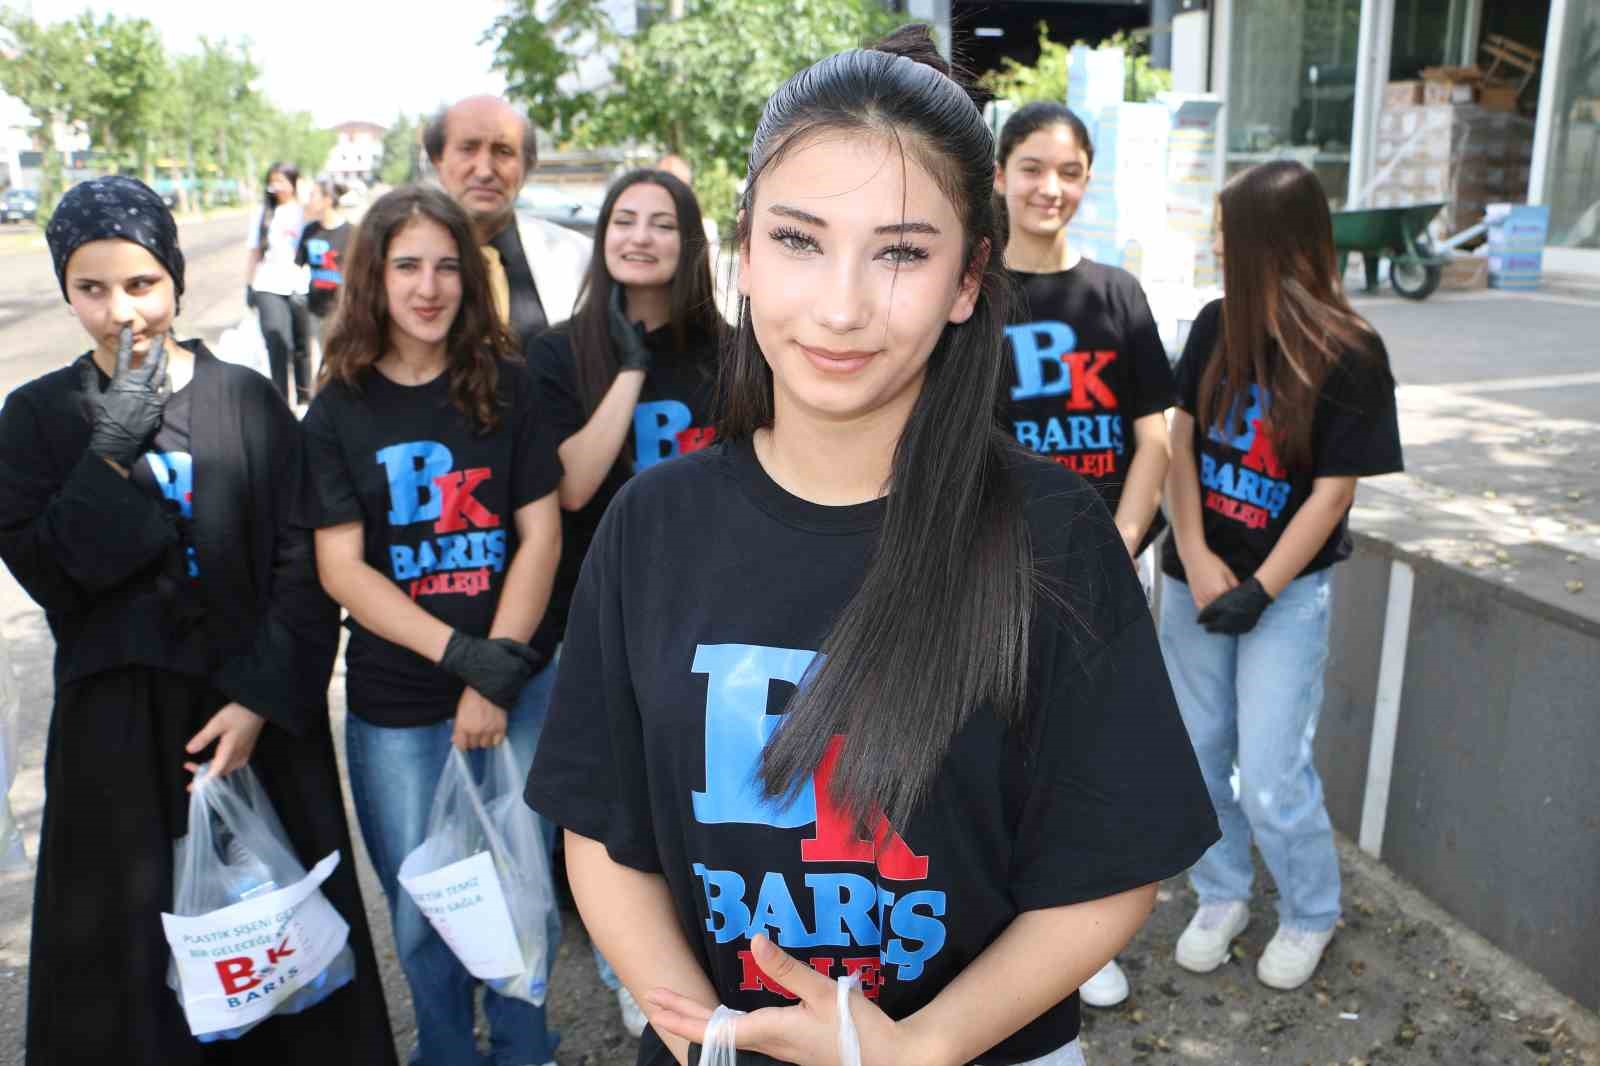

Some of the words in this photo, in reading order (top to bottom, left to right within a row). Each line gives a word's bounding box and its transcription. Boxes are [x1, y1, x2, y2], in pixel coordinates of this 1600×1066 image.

[1003, 320, 1117, 411] BK
[375, 440, 500, 534] BK
[389, 529, 508, 581] BARIŞ
